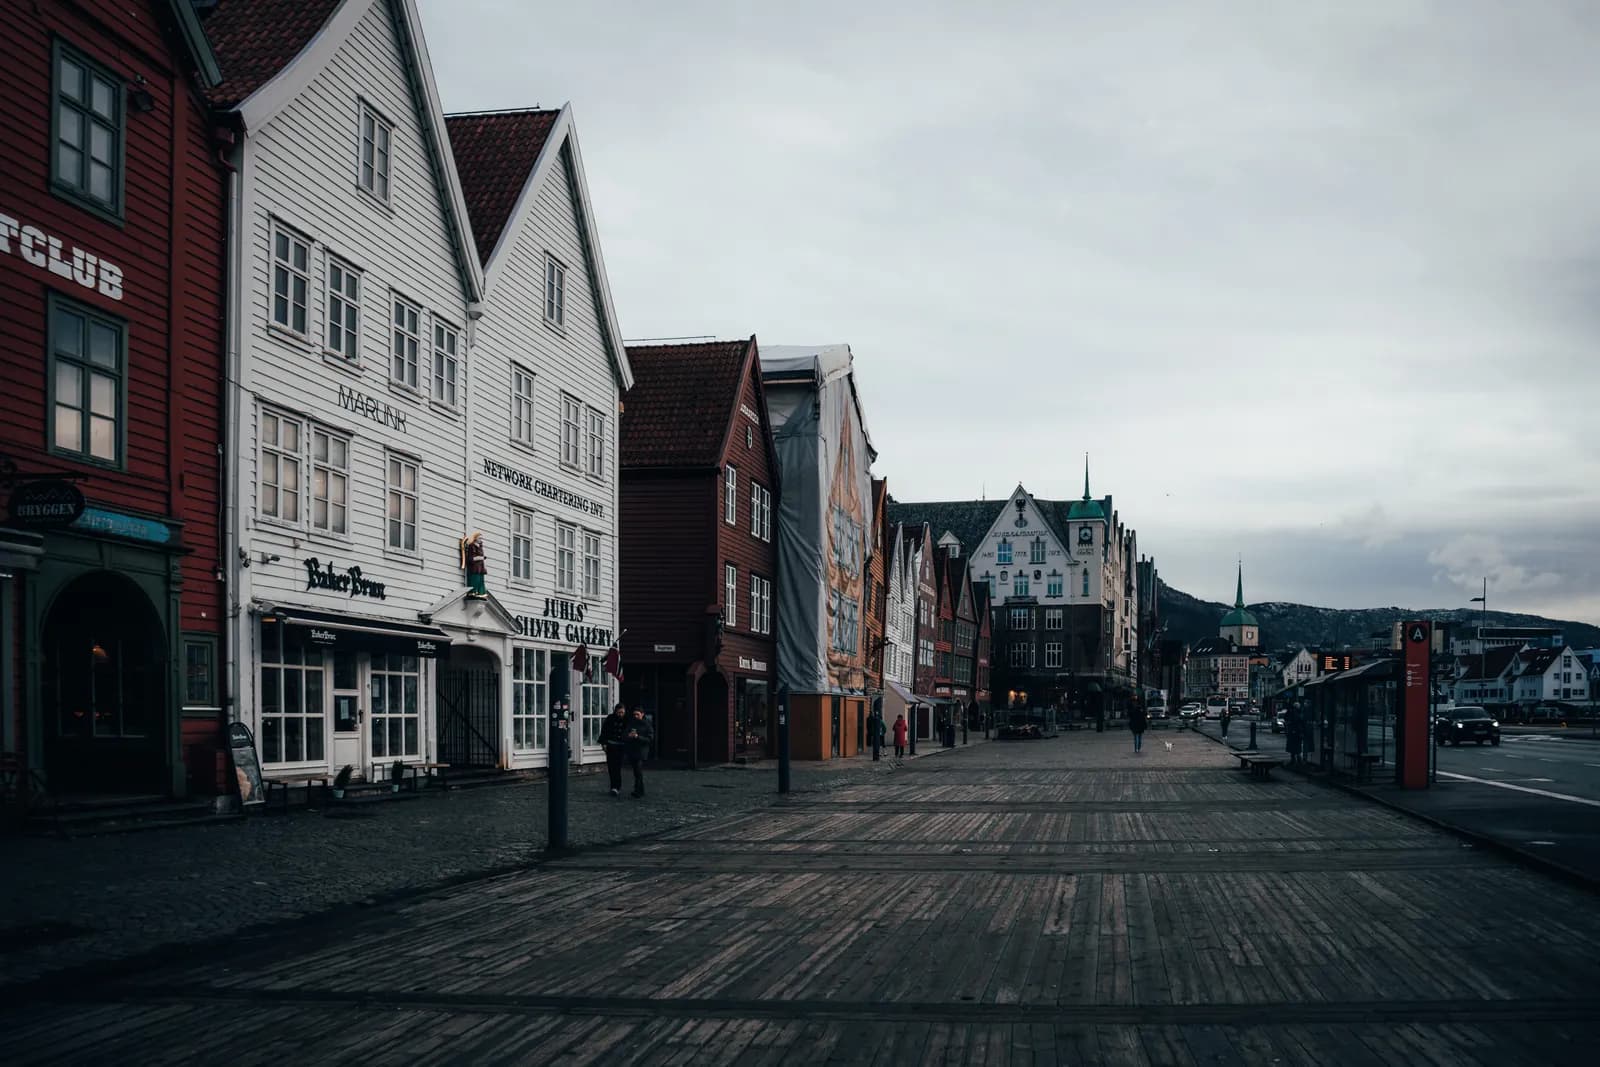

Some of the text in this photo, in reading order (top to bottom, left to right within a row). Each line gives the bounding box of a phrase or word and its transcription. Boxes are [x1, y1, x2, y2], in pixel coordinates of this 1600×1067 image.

[338, 384, 407, 434] MARLINK
[484, 458, 533, 491] NETWORK
[534, 480, 589, 513] CHARTERING
[17, 503, 77, 517] BRYGGEN
[516, 615, 613, 647] SILVER GALLERY
[1413, 627, 1424, 641] A
